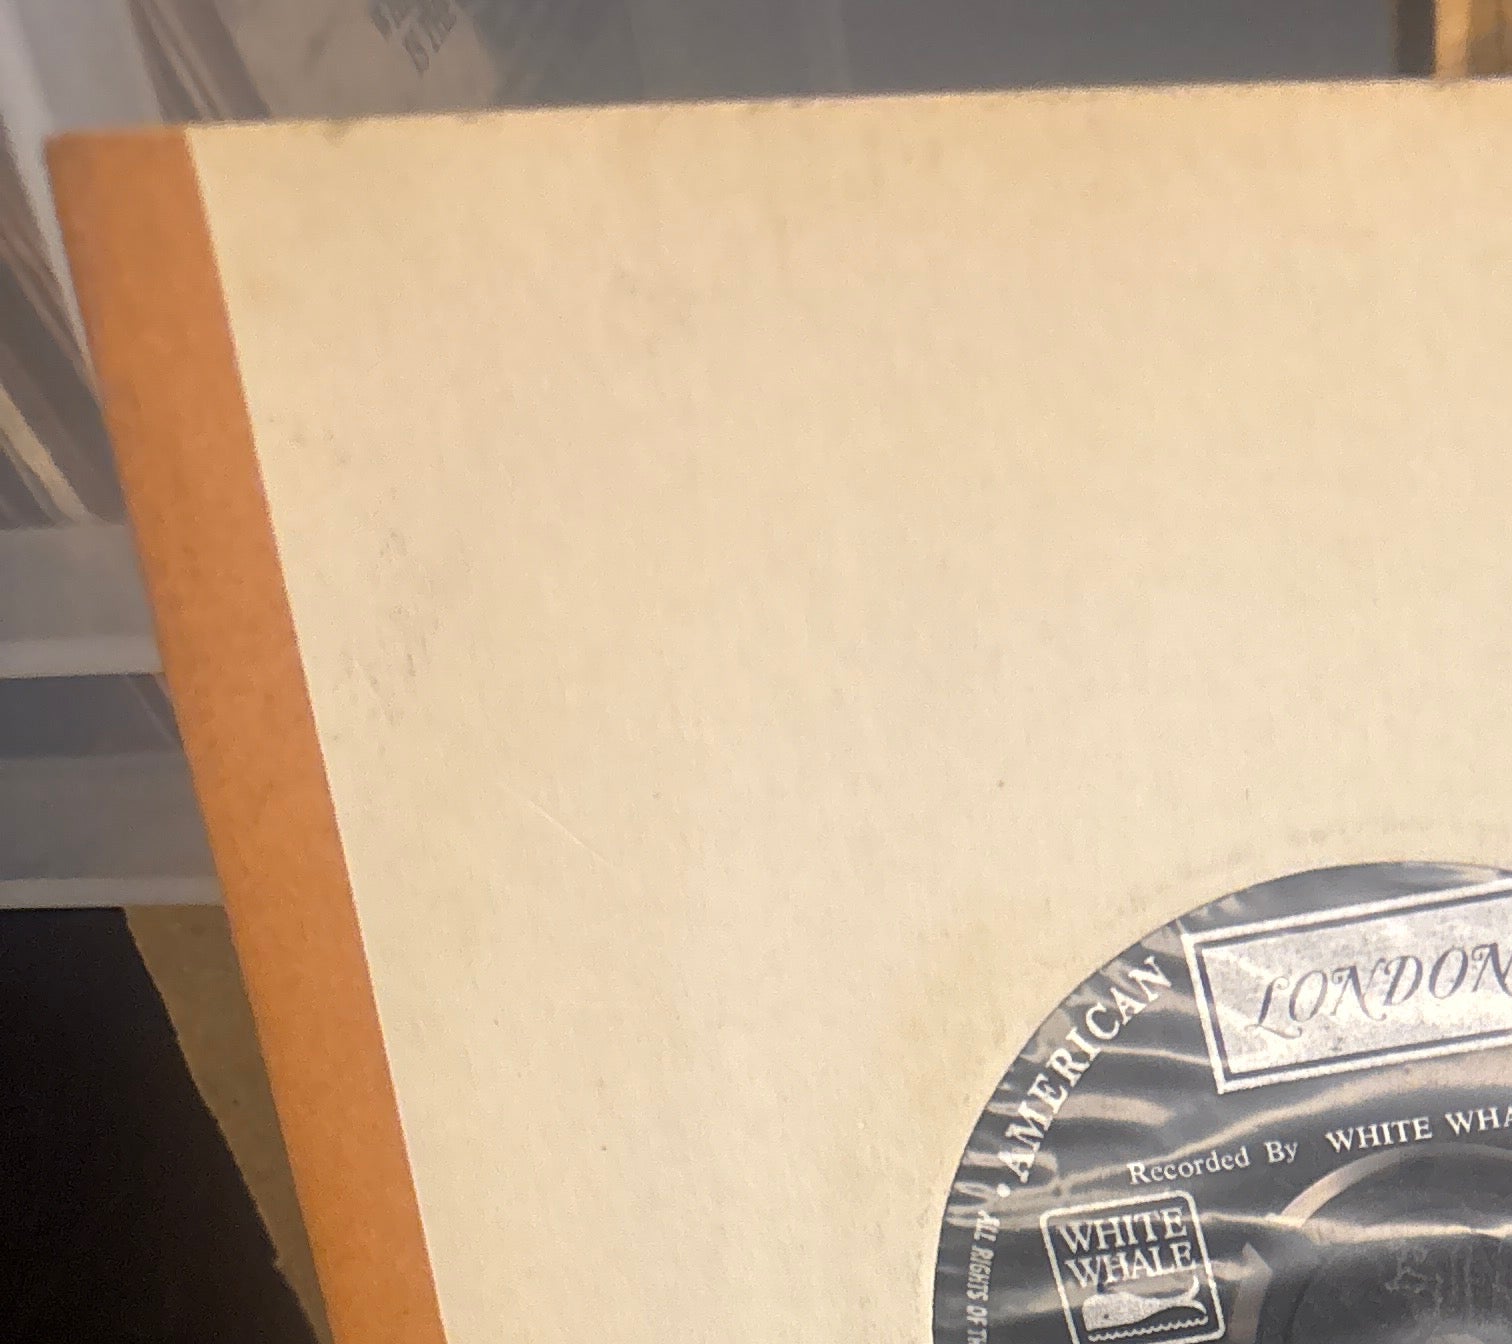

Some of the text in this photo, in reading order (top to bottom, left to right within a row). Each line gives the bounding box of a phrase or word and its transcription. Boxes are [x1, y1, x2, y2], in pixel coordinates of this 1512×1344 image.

[998, 956, 1172, 1183] AMERICAN
[1128, 1147, 1250, 1185] Recorded
[1265, 1141, 1299, 1165] By
[1324, 1116, 1433, 1153] WHITE
[973, 1210, 1000, 1242] ALL
[1055, 1207, 1187, 1254] WHITE
[966, 1244, 994, 1301] RIGHTS
[1065, 1242, 1197, 1288] WHALE
[966, 1305, 988, 1327] OF
